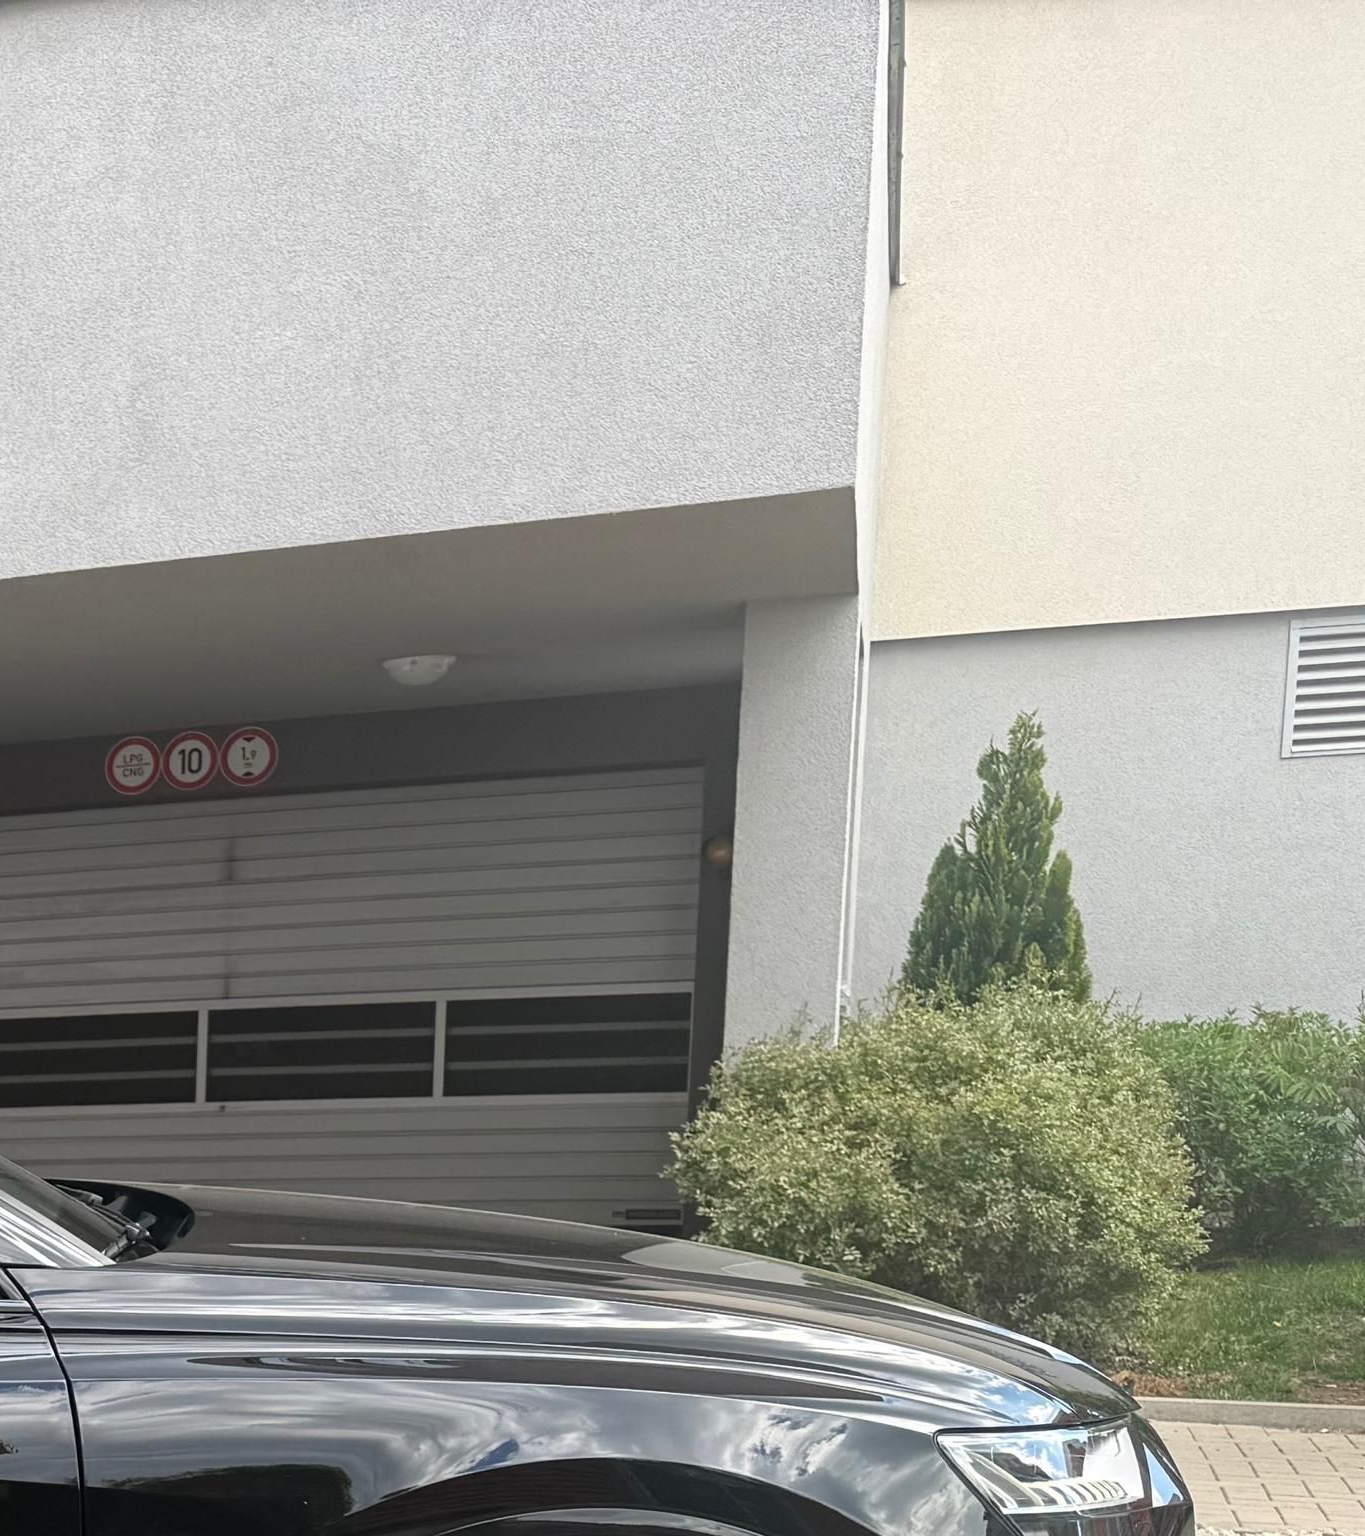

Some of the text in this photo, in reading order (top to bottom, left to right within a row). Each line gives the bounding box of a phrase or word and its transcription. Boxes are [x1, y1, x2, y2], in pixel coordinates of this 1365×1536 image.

[122, 753, 144, 764] LPG
[178, 748, 203, 775] 10
[122, 766, 145, 778] CNG
